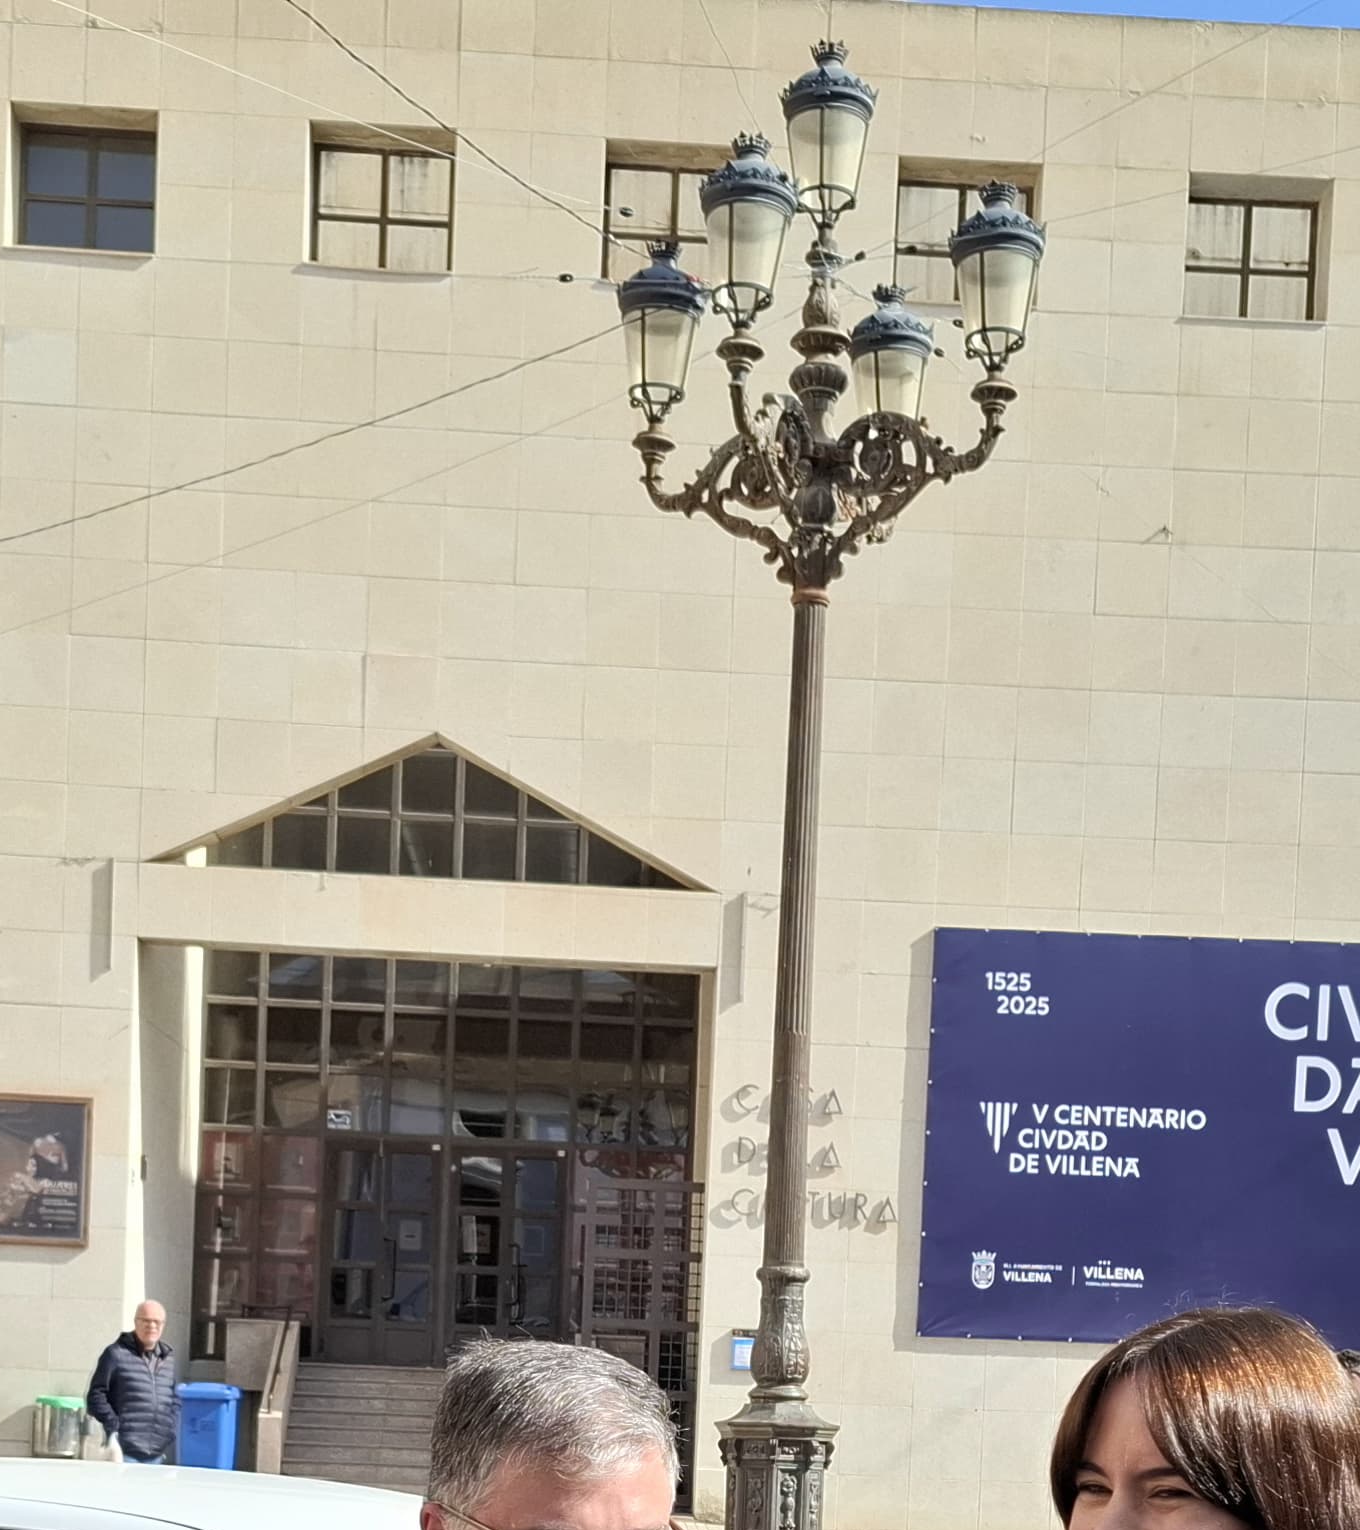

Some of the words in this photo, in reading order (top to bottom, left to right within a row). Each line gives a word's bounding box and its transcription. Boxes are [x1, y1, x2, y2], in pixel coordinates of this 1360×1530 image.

[985, 971, 1031, 992] 1525
[996, 995, 1050, 1016] 2025
[1032, 1103, 1049, 1124] V
[1054, 1104, 1207, 1130] CENTENARIO
[1018, 1128, 1108, 1151] CIVDAD
[1009, 1153, 1039, 1174] DE
[1045, 1154, 1140, 1178] VILLENA
[731, 1188, 898, 1224] CTURA
[1003, 1270, 1052, 1283] VILLENA
[1083, 1266, 1144, 1281] VILLENA
